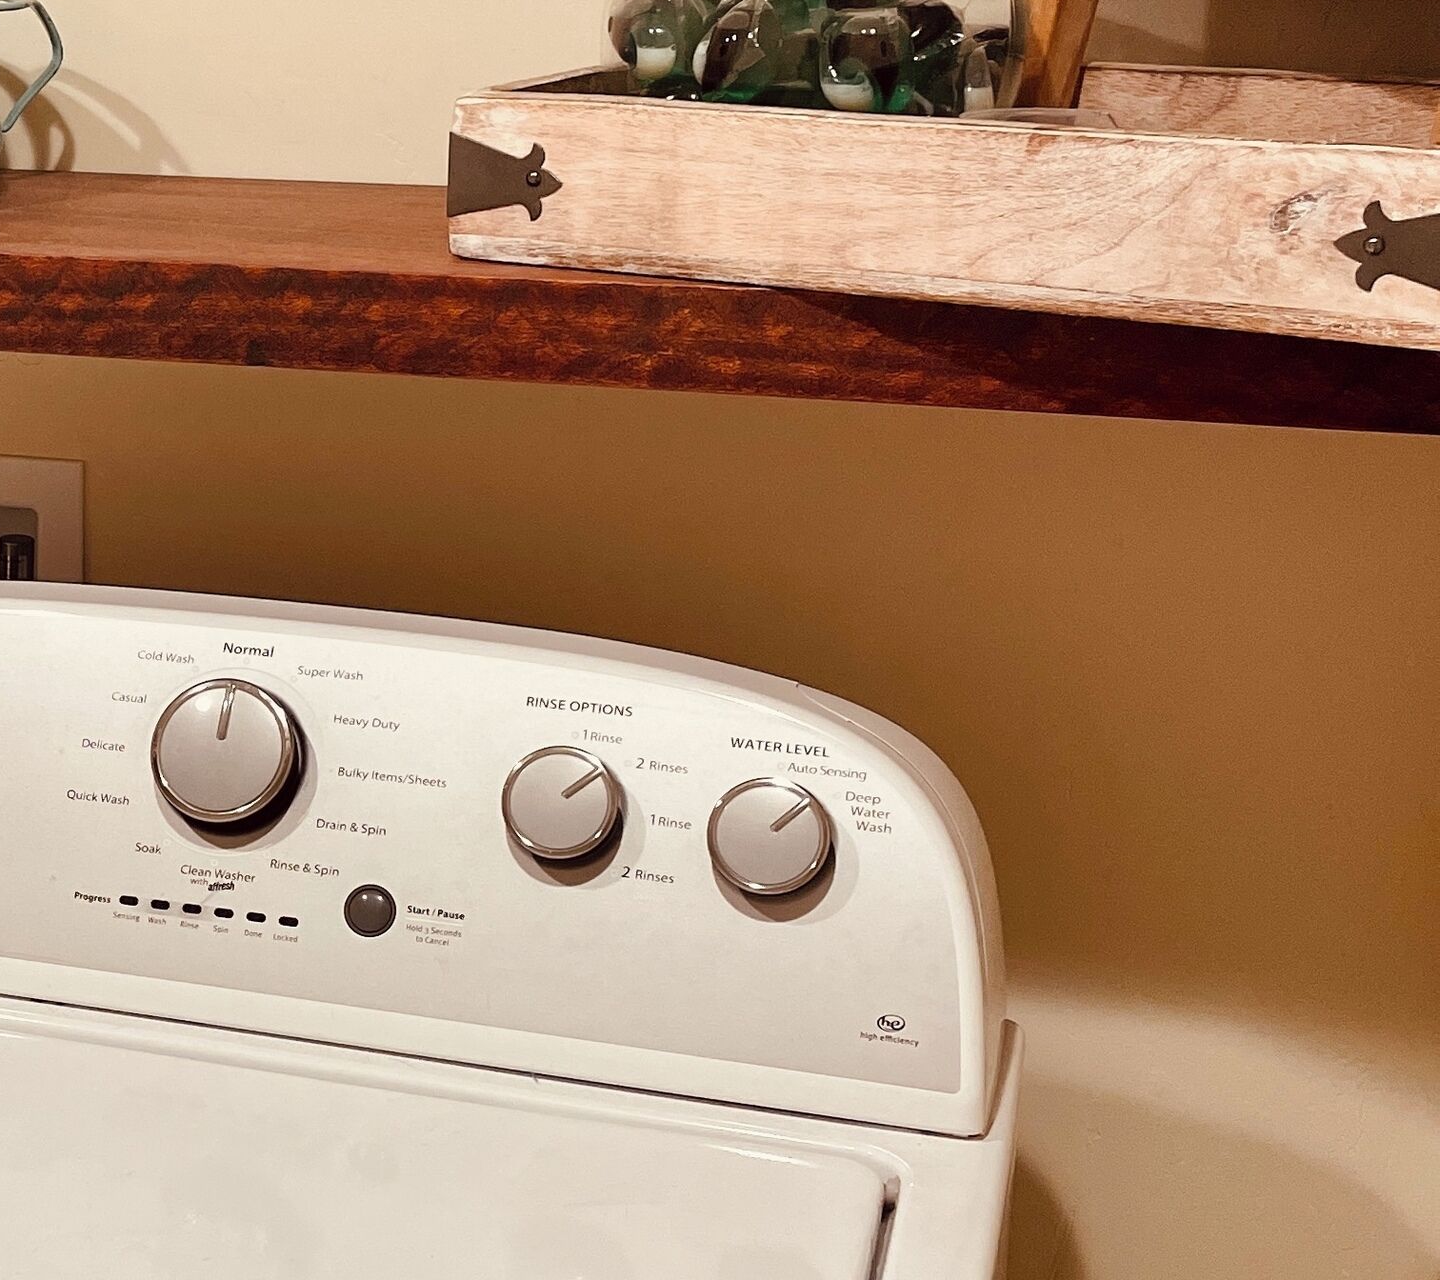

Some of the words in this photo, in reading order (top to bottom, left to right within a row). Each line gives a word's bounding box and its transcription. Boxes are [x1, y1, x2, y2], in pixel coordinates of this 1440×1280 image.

[137, 649, 163, 663] Cold
[166, 652, 195, 665] Wash
[222, 642, 275, 659] Normal
[297, 665, 330, 681] Super
[332, 668, 364, 681] Wash
[111, 691, 148, 704] Casual
[526, 696, 567, 712] RINSE
[569, 701, 634, 717] OPTIONS
[333, 714, 370, 732] Heavy
[372, 718, 400, 732] Duty
[81, 738, 126, 752] Delicate
[590, 732, 623, 746] Rinse
[730, 737, 783, 754] WATER
[786, 742, 830, 758] LEVEL
[635, 757, 646, 770] 2
[648, 760, 689, 775] Rinses
[787, 762, 818, 776] Auto
[819, 765, 867, 783] Sensing
[337, 766, 369, 783] Bulky
[371, 770, 448, 789] Items/Sheets
[66, 789, 97, 804] Quick
[100, 792, 130, 806] Wash
[844, 791, 881, 806] Deep
[850, 805, 891, 820] Water
[316, 819, 347, 833] Drain
[349, 822, 358, 833] &
[360, 823, 387, 838] Spin
[658, 817, 692, 830] Rinse
[856, 821, 893, 835] Wash
[135, 842, 162, 855] Soak
[181, 864, 211, 878] Clean
[215, 869, 256, 883] Washer
[270, 858, 300, 873] Rinse
[303, 863, 312, 874] &
[314, 864, 340, 878] Spin
[621, 865, 631, 878] 2
[635, 868, 675, 884] Rinses
[190, 877, 208, 886] with
[208, 881, 235, 891] affresh
[74, 891, 111, 904] Progress
[113, 911, 140, 922] Sensing
[407, 905, 430, 915] Start
[437, 909, 465, 920] Pause
[148, 916, 167, 925] Wash
[180, 920, 199, 930] Rinse
[213, 925, 229, 934] Spin
[244, 929, 262, 938] Done
[406, 924, 423, 932] Hold
[431, 927, 462, 937] Seconds
[273, 933, 298, 943] Locked
[425, 937, 449, 946] Cancel
[878, 1015, 905, 1031] he
[860, 1032, 877, 1041] high
[880, 1035, 919, 1048] efficiency
